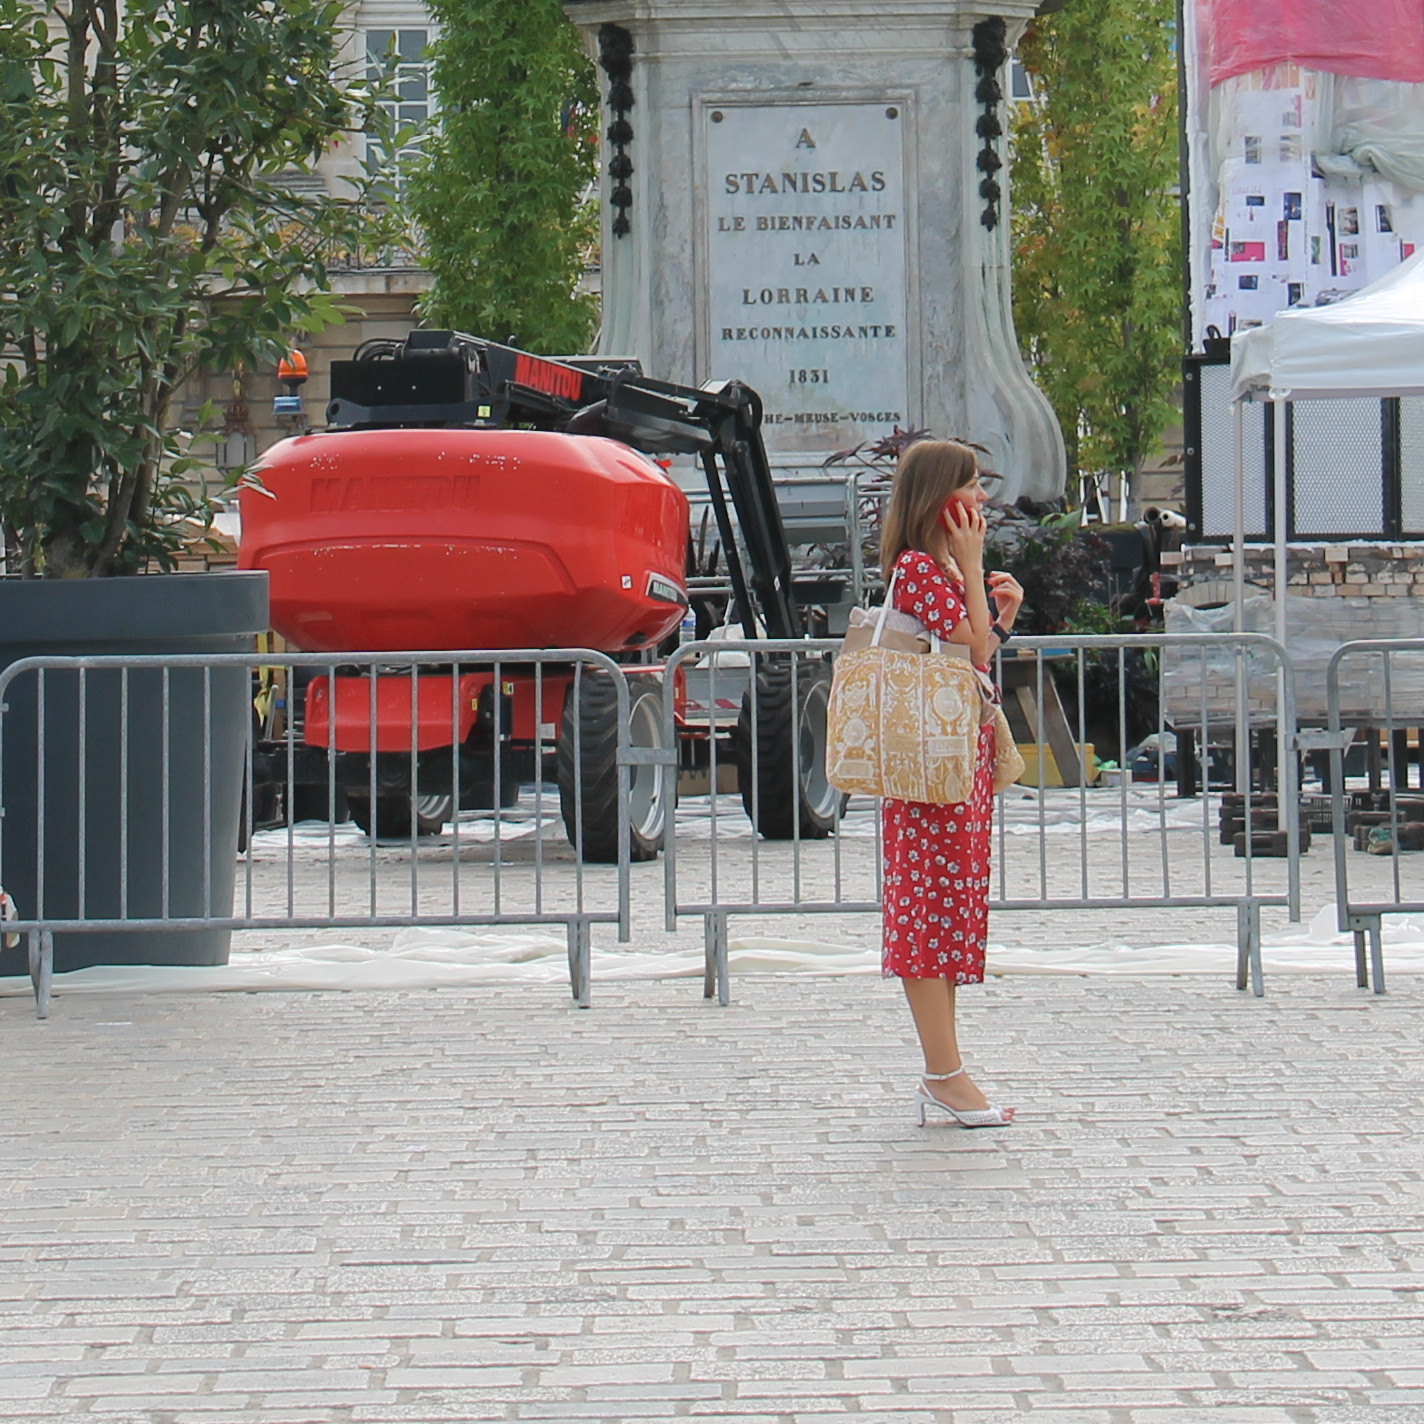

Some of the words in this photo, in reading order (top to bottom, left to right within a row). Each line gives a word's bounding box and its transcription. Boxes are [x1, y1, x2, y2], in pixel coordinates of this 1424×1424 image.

[794, 127, 816, 150] A
[725, 171, 887, 194] STANISLAS
[718, 216, 745, 232] LE
[755, 213, 896, 231] BIENFAISANT
[793, 252, 820, 266] LA
[742, 286, 875, 305] LORRAINE
[721, 324, 897, 341] RECONNAISSANTE
[516, 354, 583, 401] MANITOU
[788, 368, 830, 384] 1831
[310, 474, 481, 513] MANITOU
